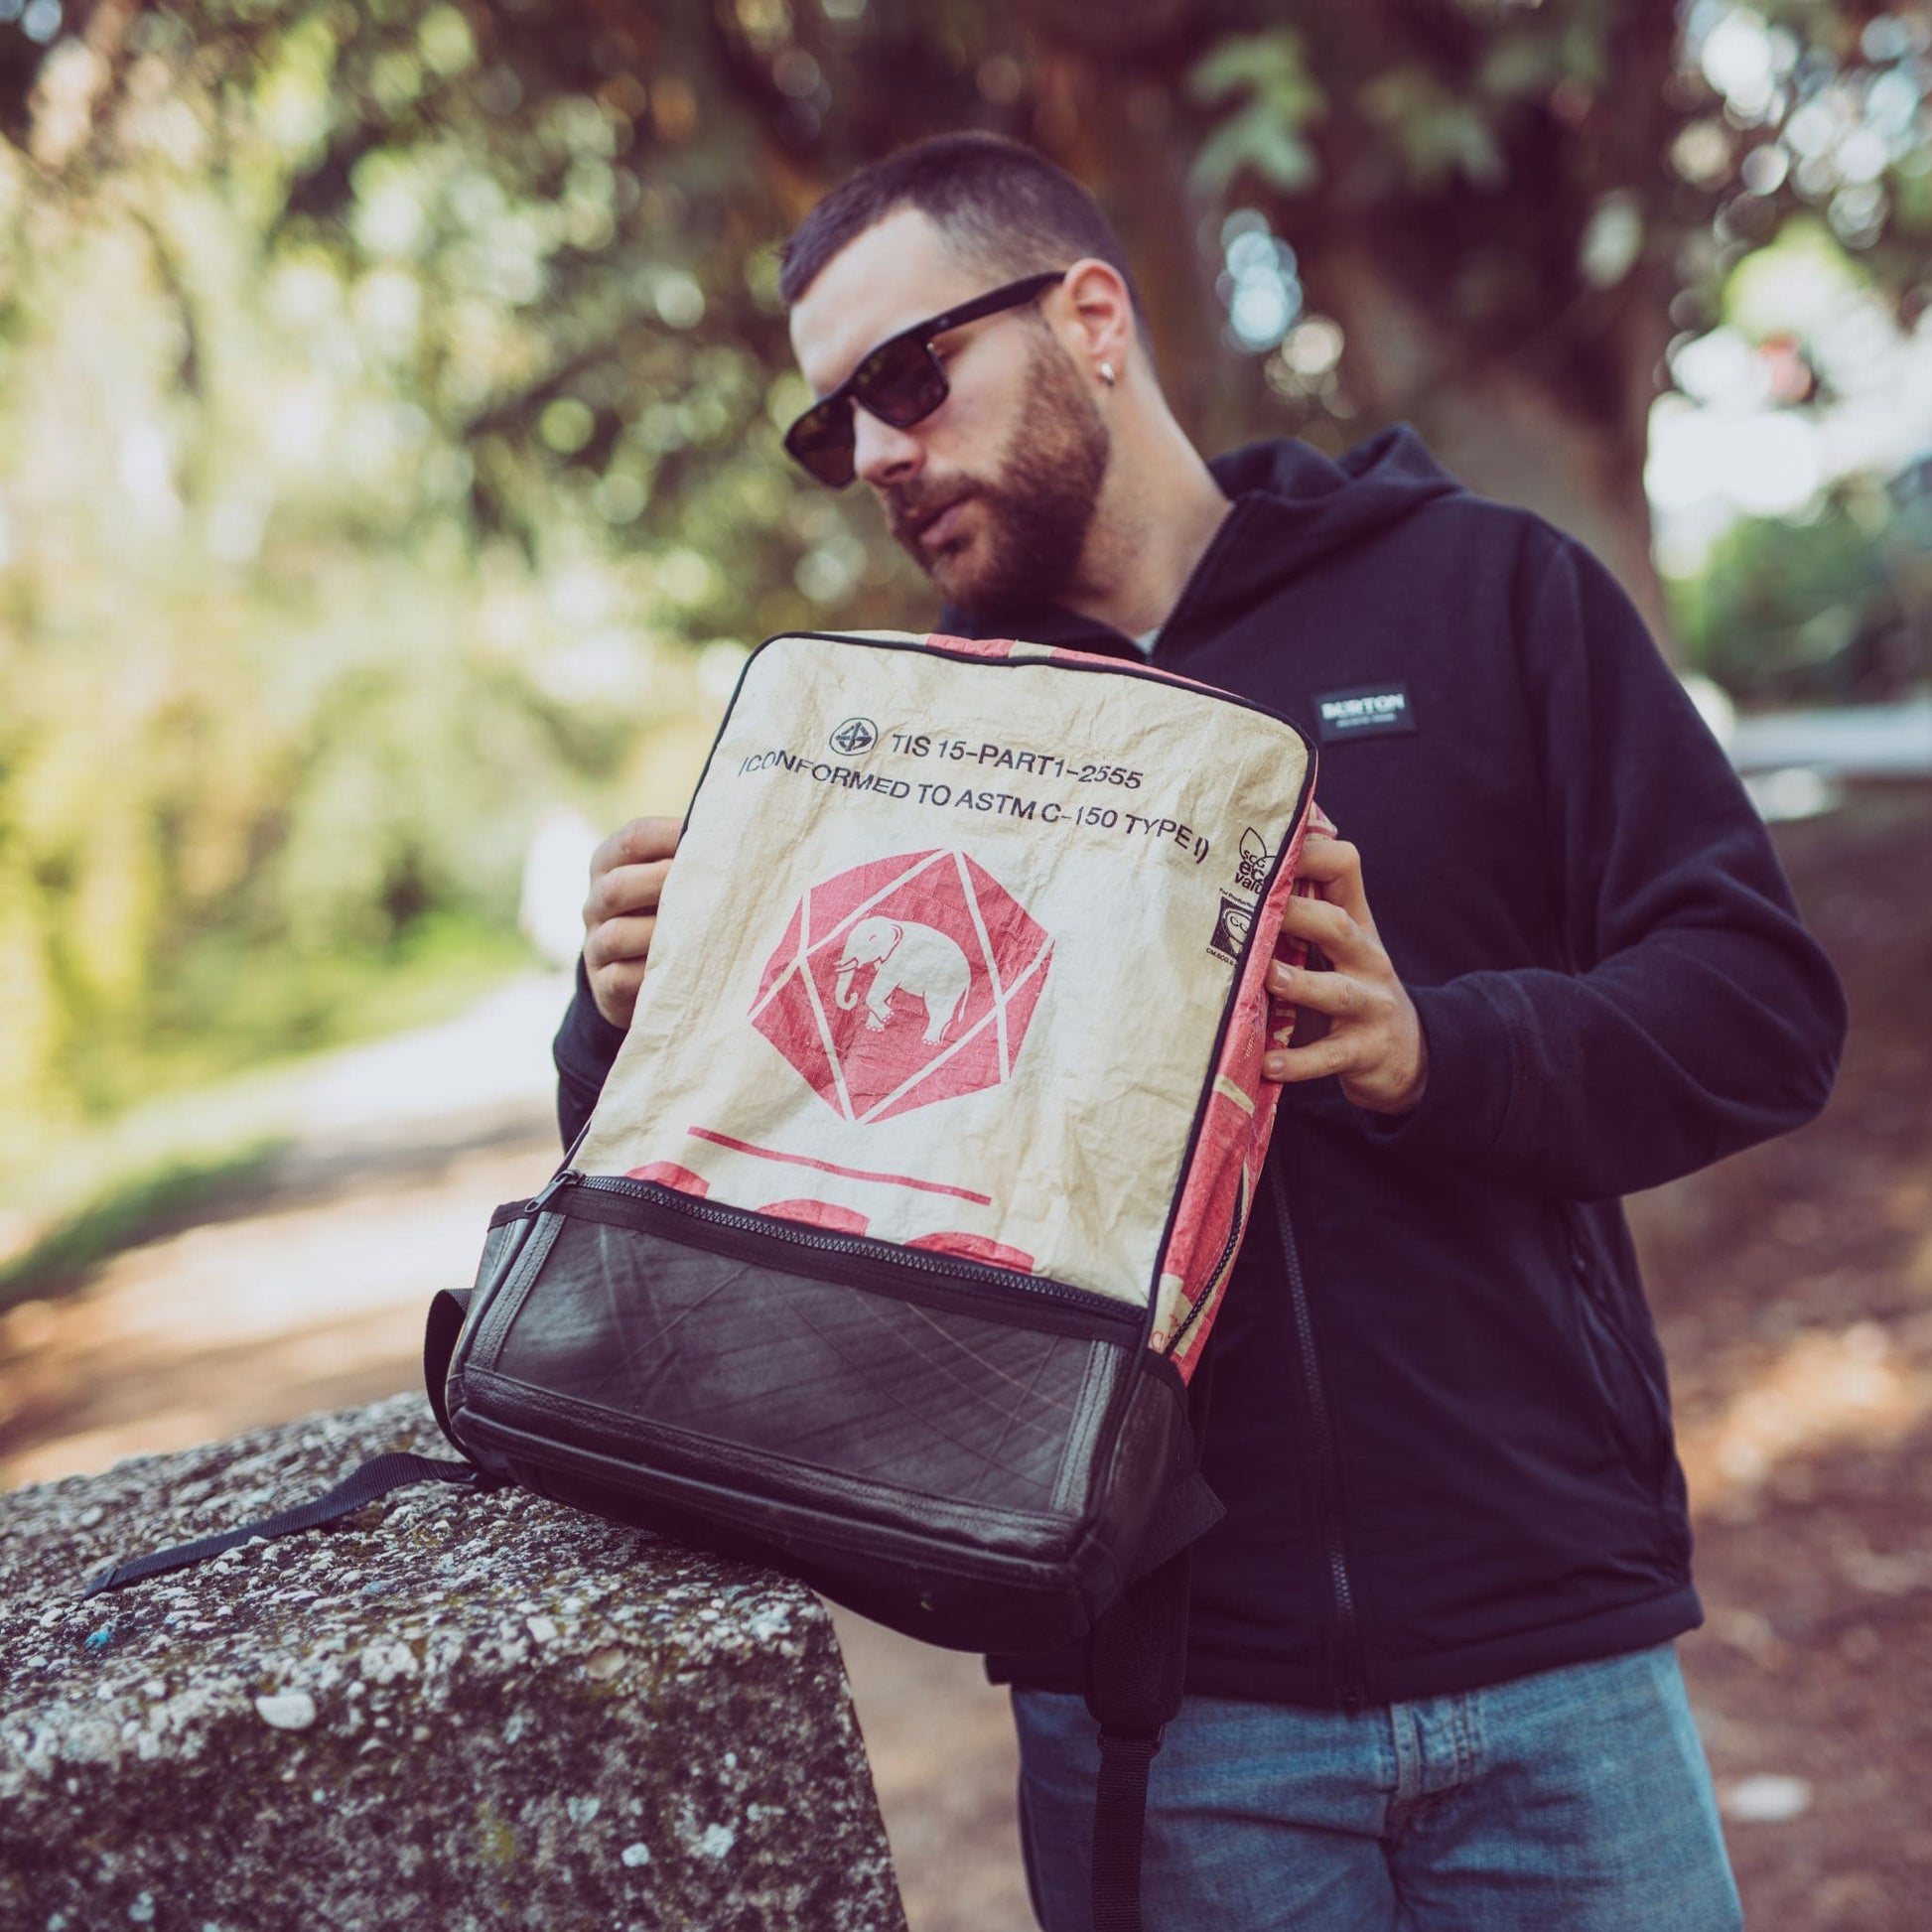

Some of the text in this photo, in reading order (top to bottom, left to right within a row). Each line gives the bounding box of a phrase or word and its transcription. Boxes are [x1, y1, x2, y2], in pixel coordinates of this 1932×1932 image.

[892, 734, 1144, 790] TIS 15-PART1-2555
[917, 782, 952, 806] TO
[955, 789, 1037, 821] ASTM
[1040, 802, 1119, 828] C-150
[1125, 813, 1193, 850] TYPE
